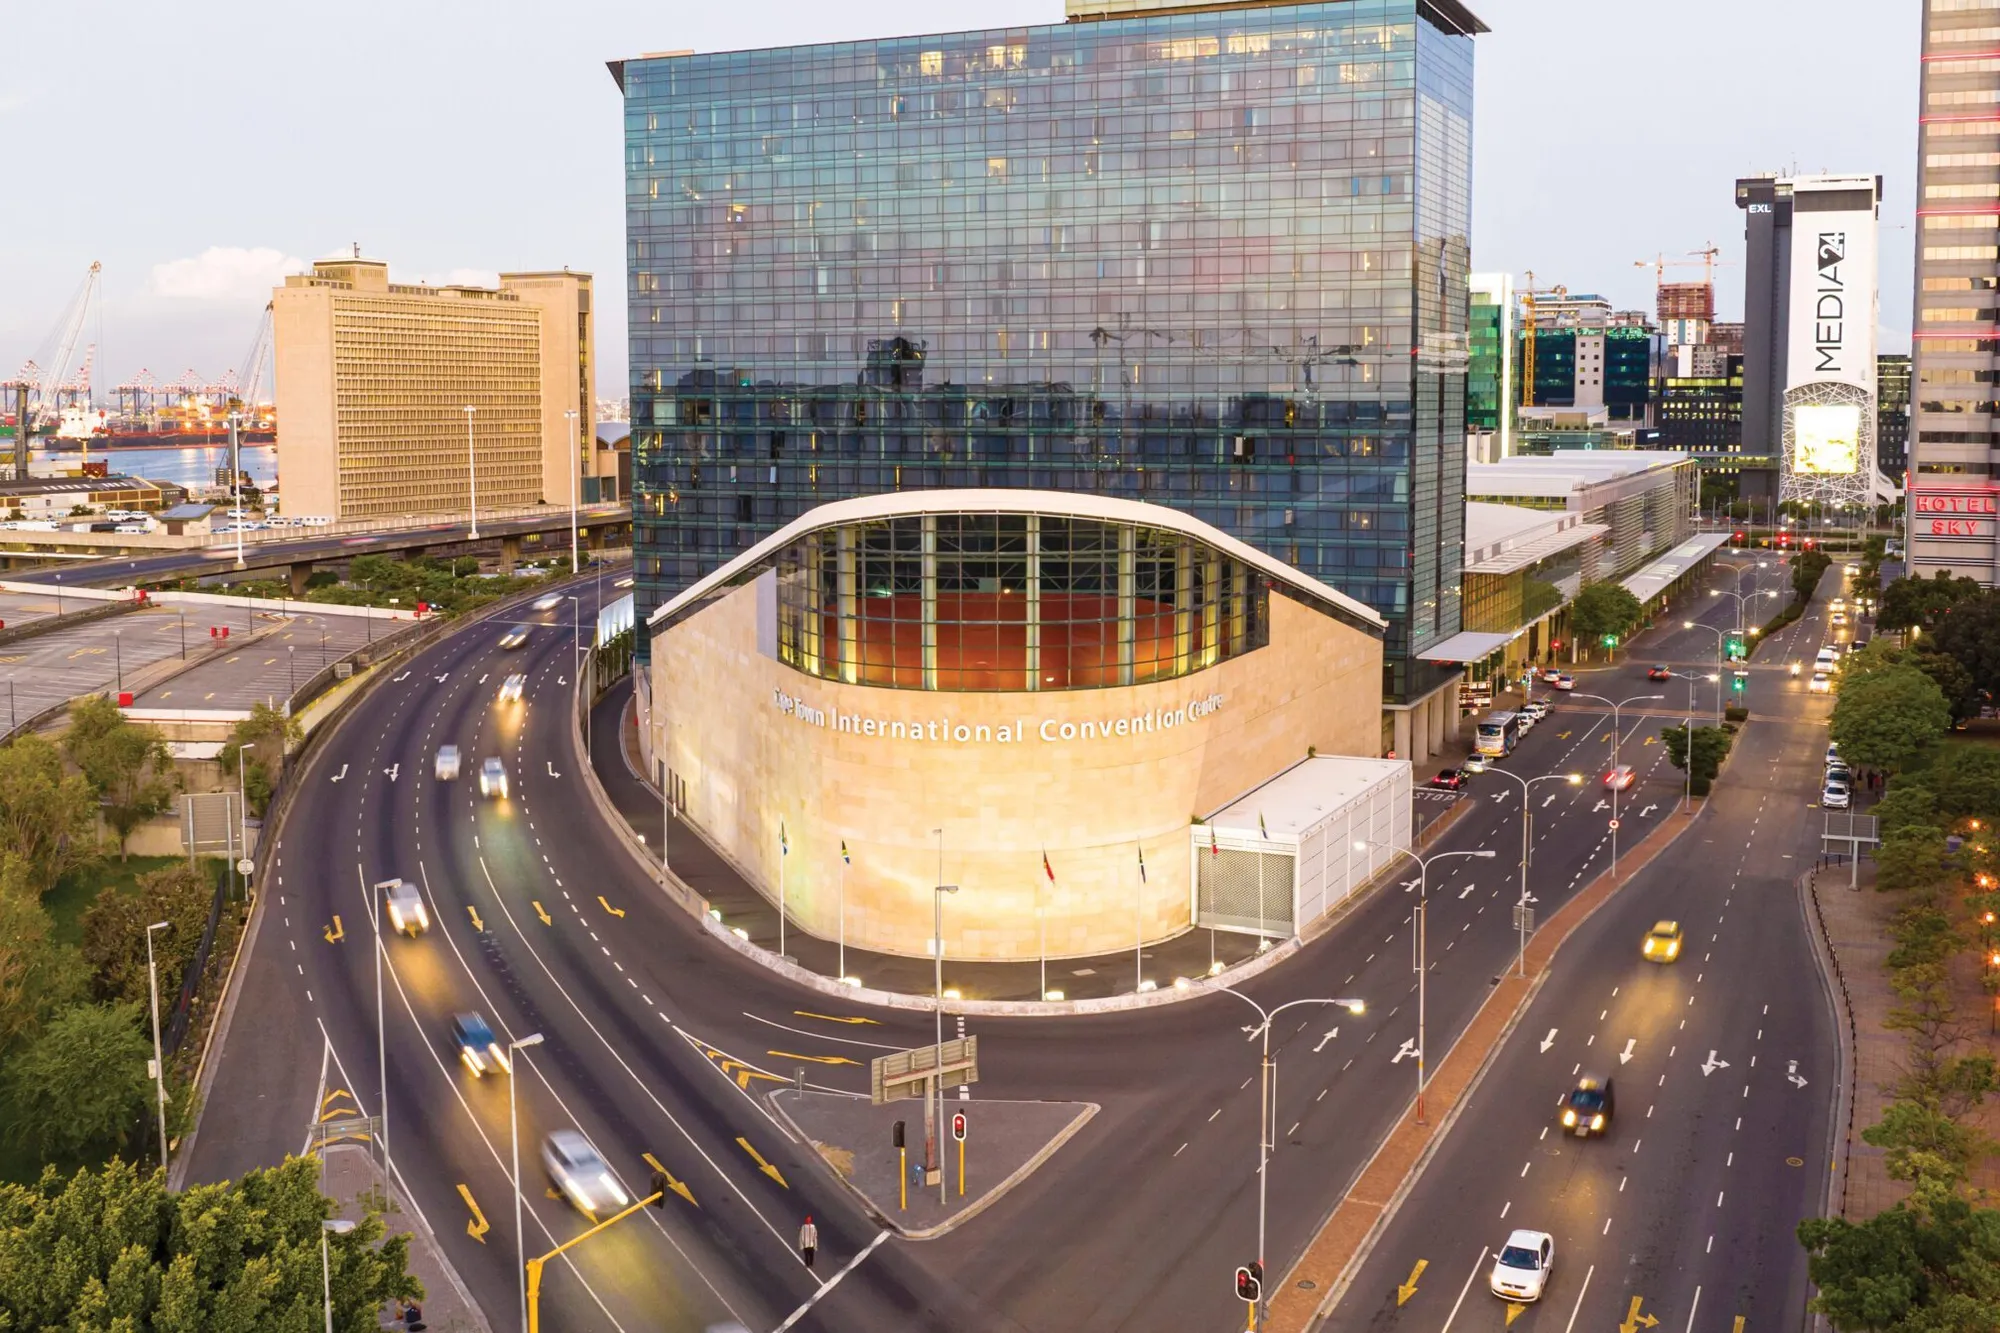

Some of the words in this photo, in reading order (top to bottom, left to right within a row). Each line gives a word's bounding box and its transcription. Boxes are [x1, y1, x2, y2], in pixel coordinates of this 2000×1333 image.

[1748, 204, 1771, 213] EXL
[1815, 232, 1845, 371] MEDIA24
[1916, 496, 1996, 512] HOTEL
[1932, 519, 1977, 535] SKY
[794, 697, 825, 728] Town
[831, 706, 1023, 743] International
[1039, 708, 1185, 742] Convention
[1187, 693, 1223, 722] Centre
[1412, 791, 1457, 801] STOP
